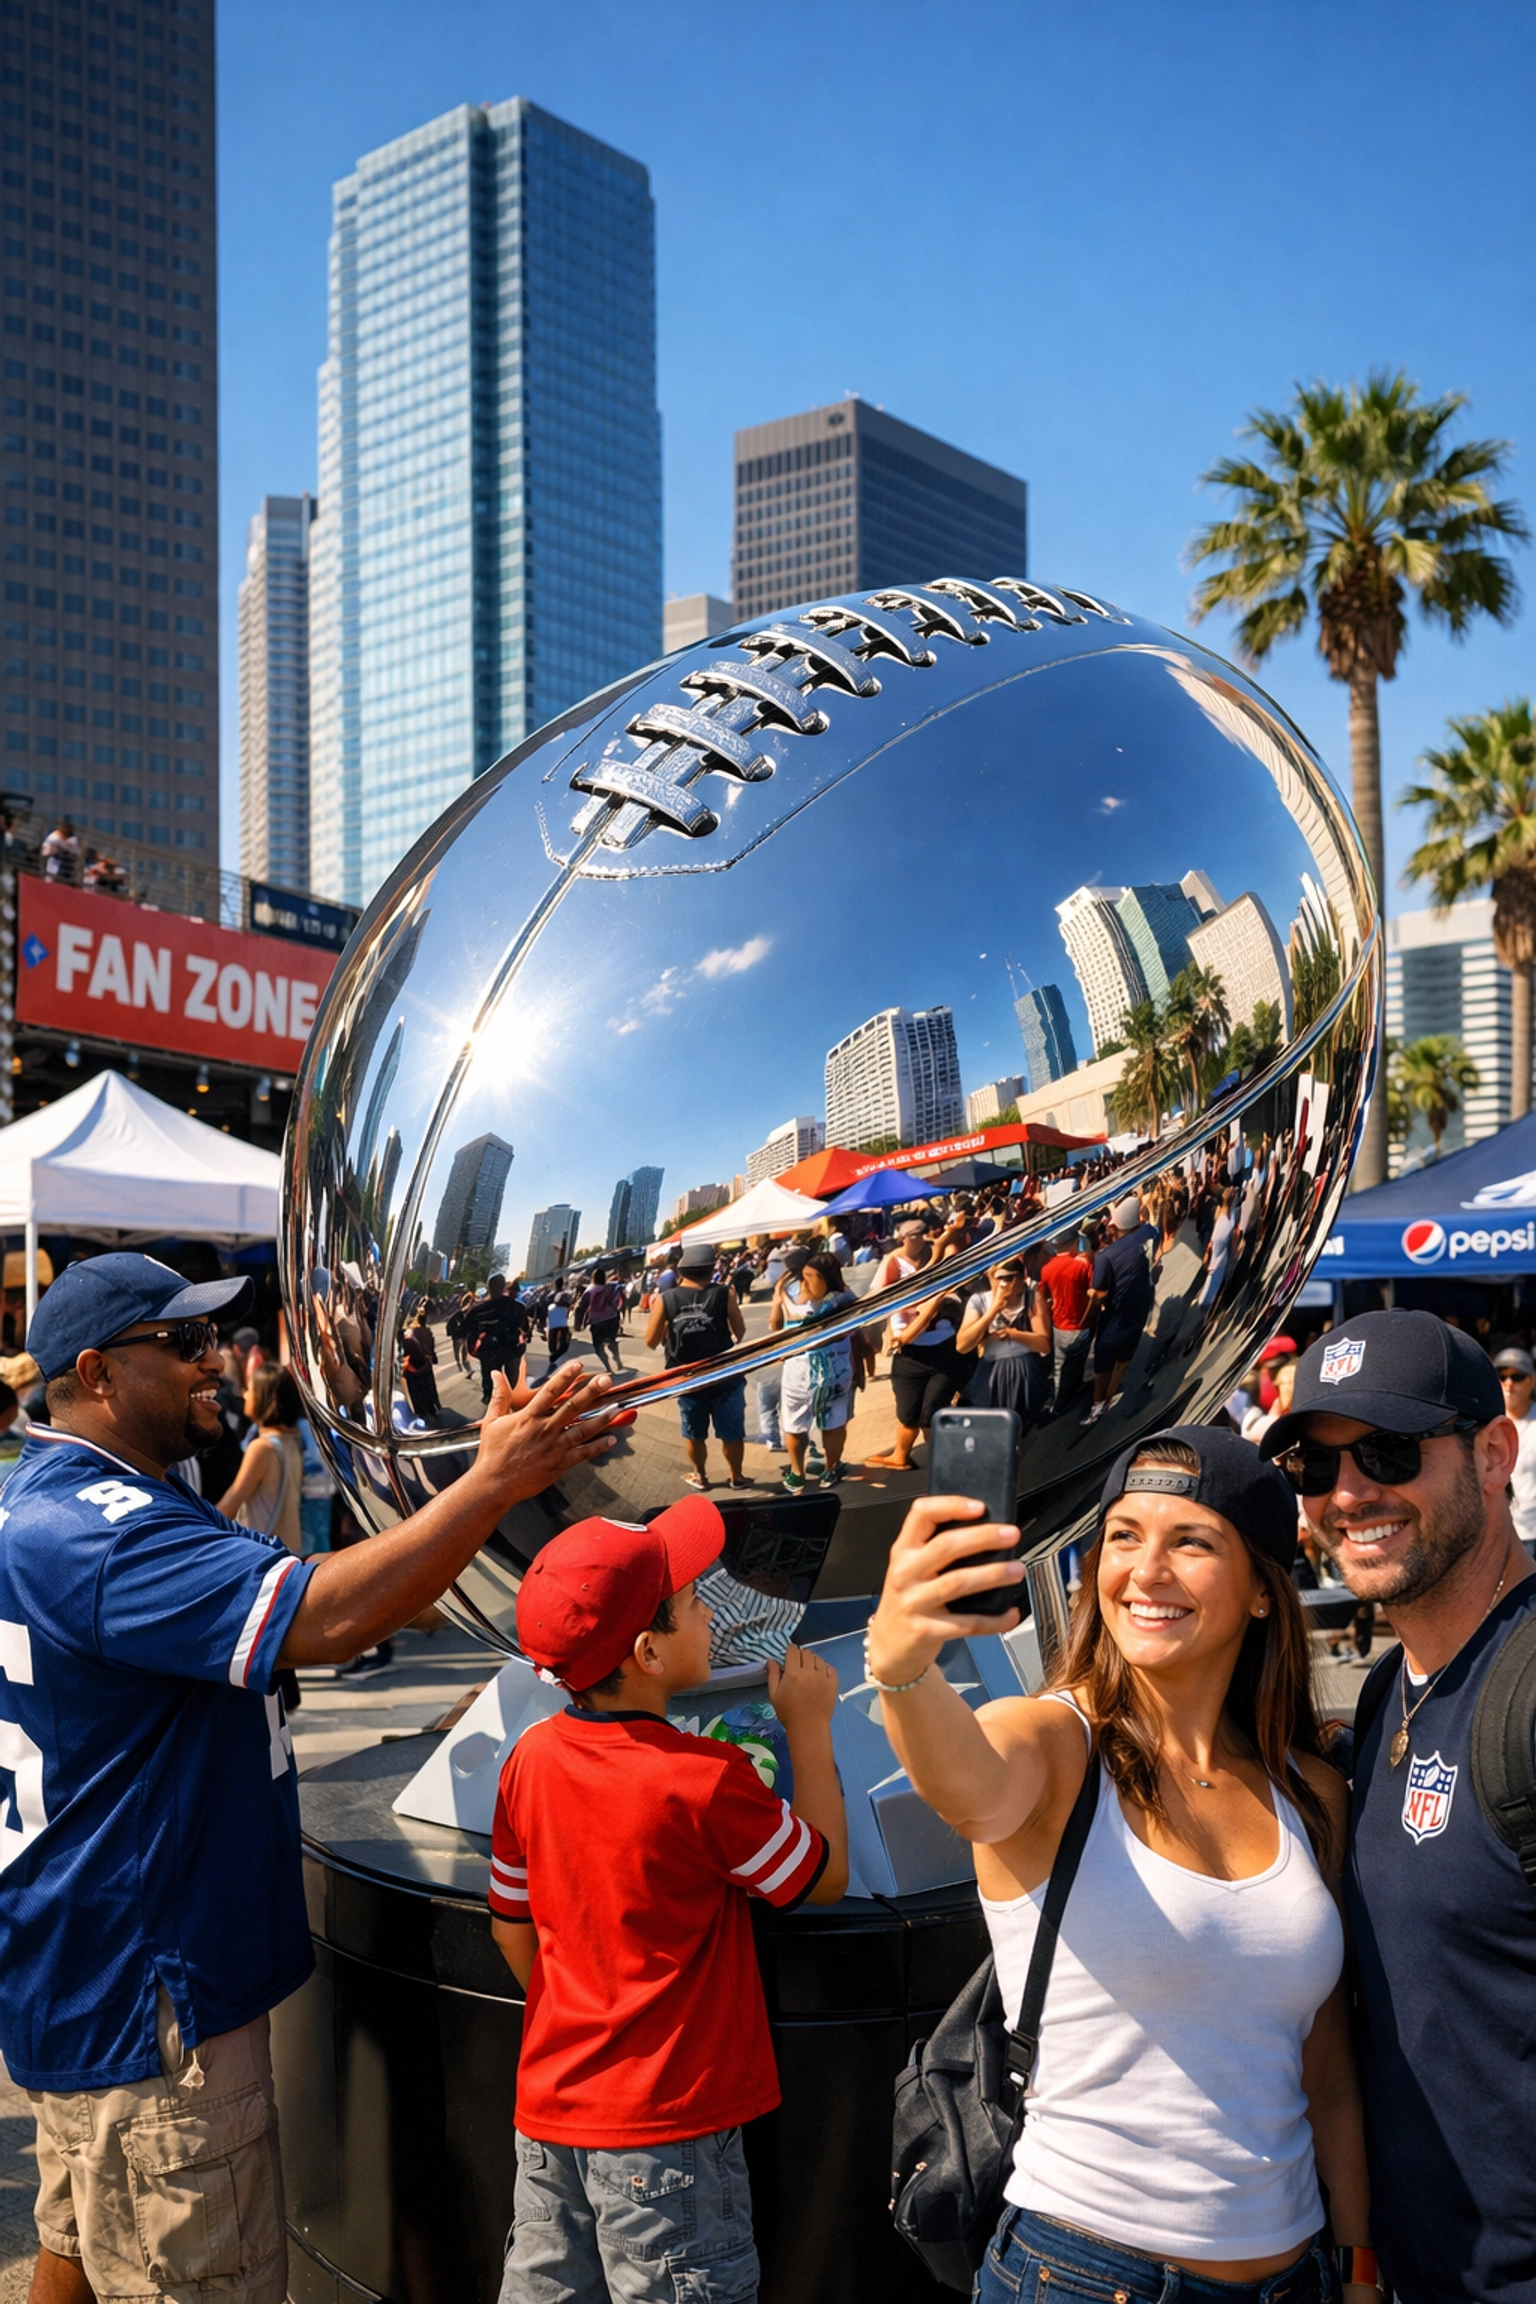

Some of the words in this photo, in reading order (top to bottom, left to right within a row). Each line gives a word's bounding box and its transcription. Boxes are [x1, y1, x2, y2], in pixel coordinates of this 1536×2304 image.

[56, 922, 172, 1014] FAN
[184, 954, 318, 1042] ZONE
[1449, 1221, 1535, 1259] pepsi
[1405, 1791, 1442, 1828] NFL
